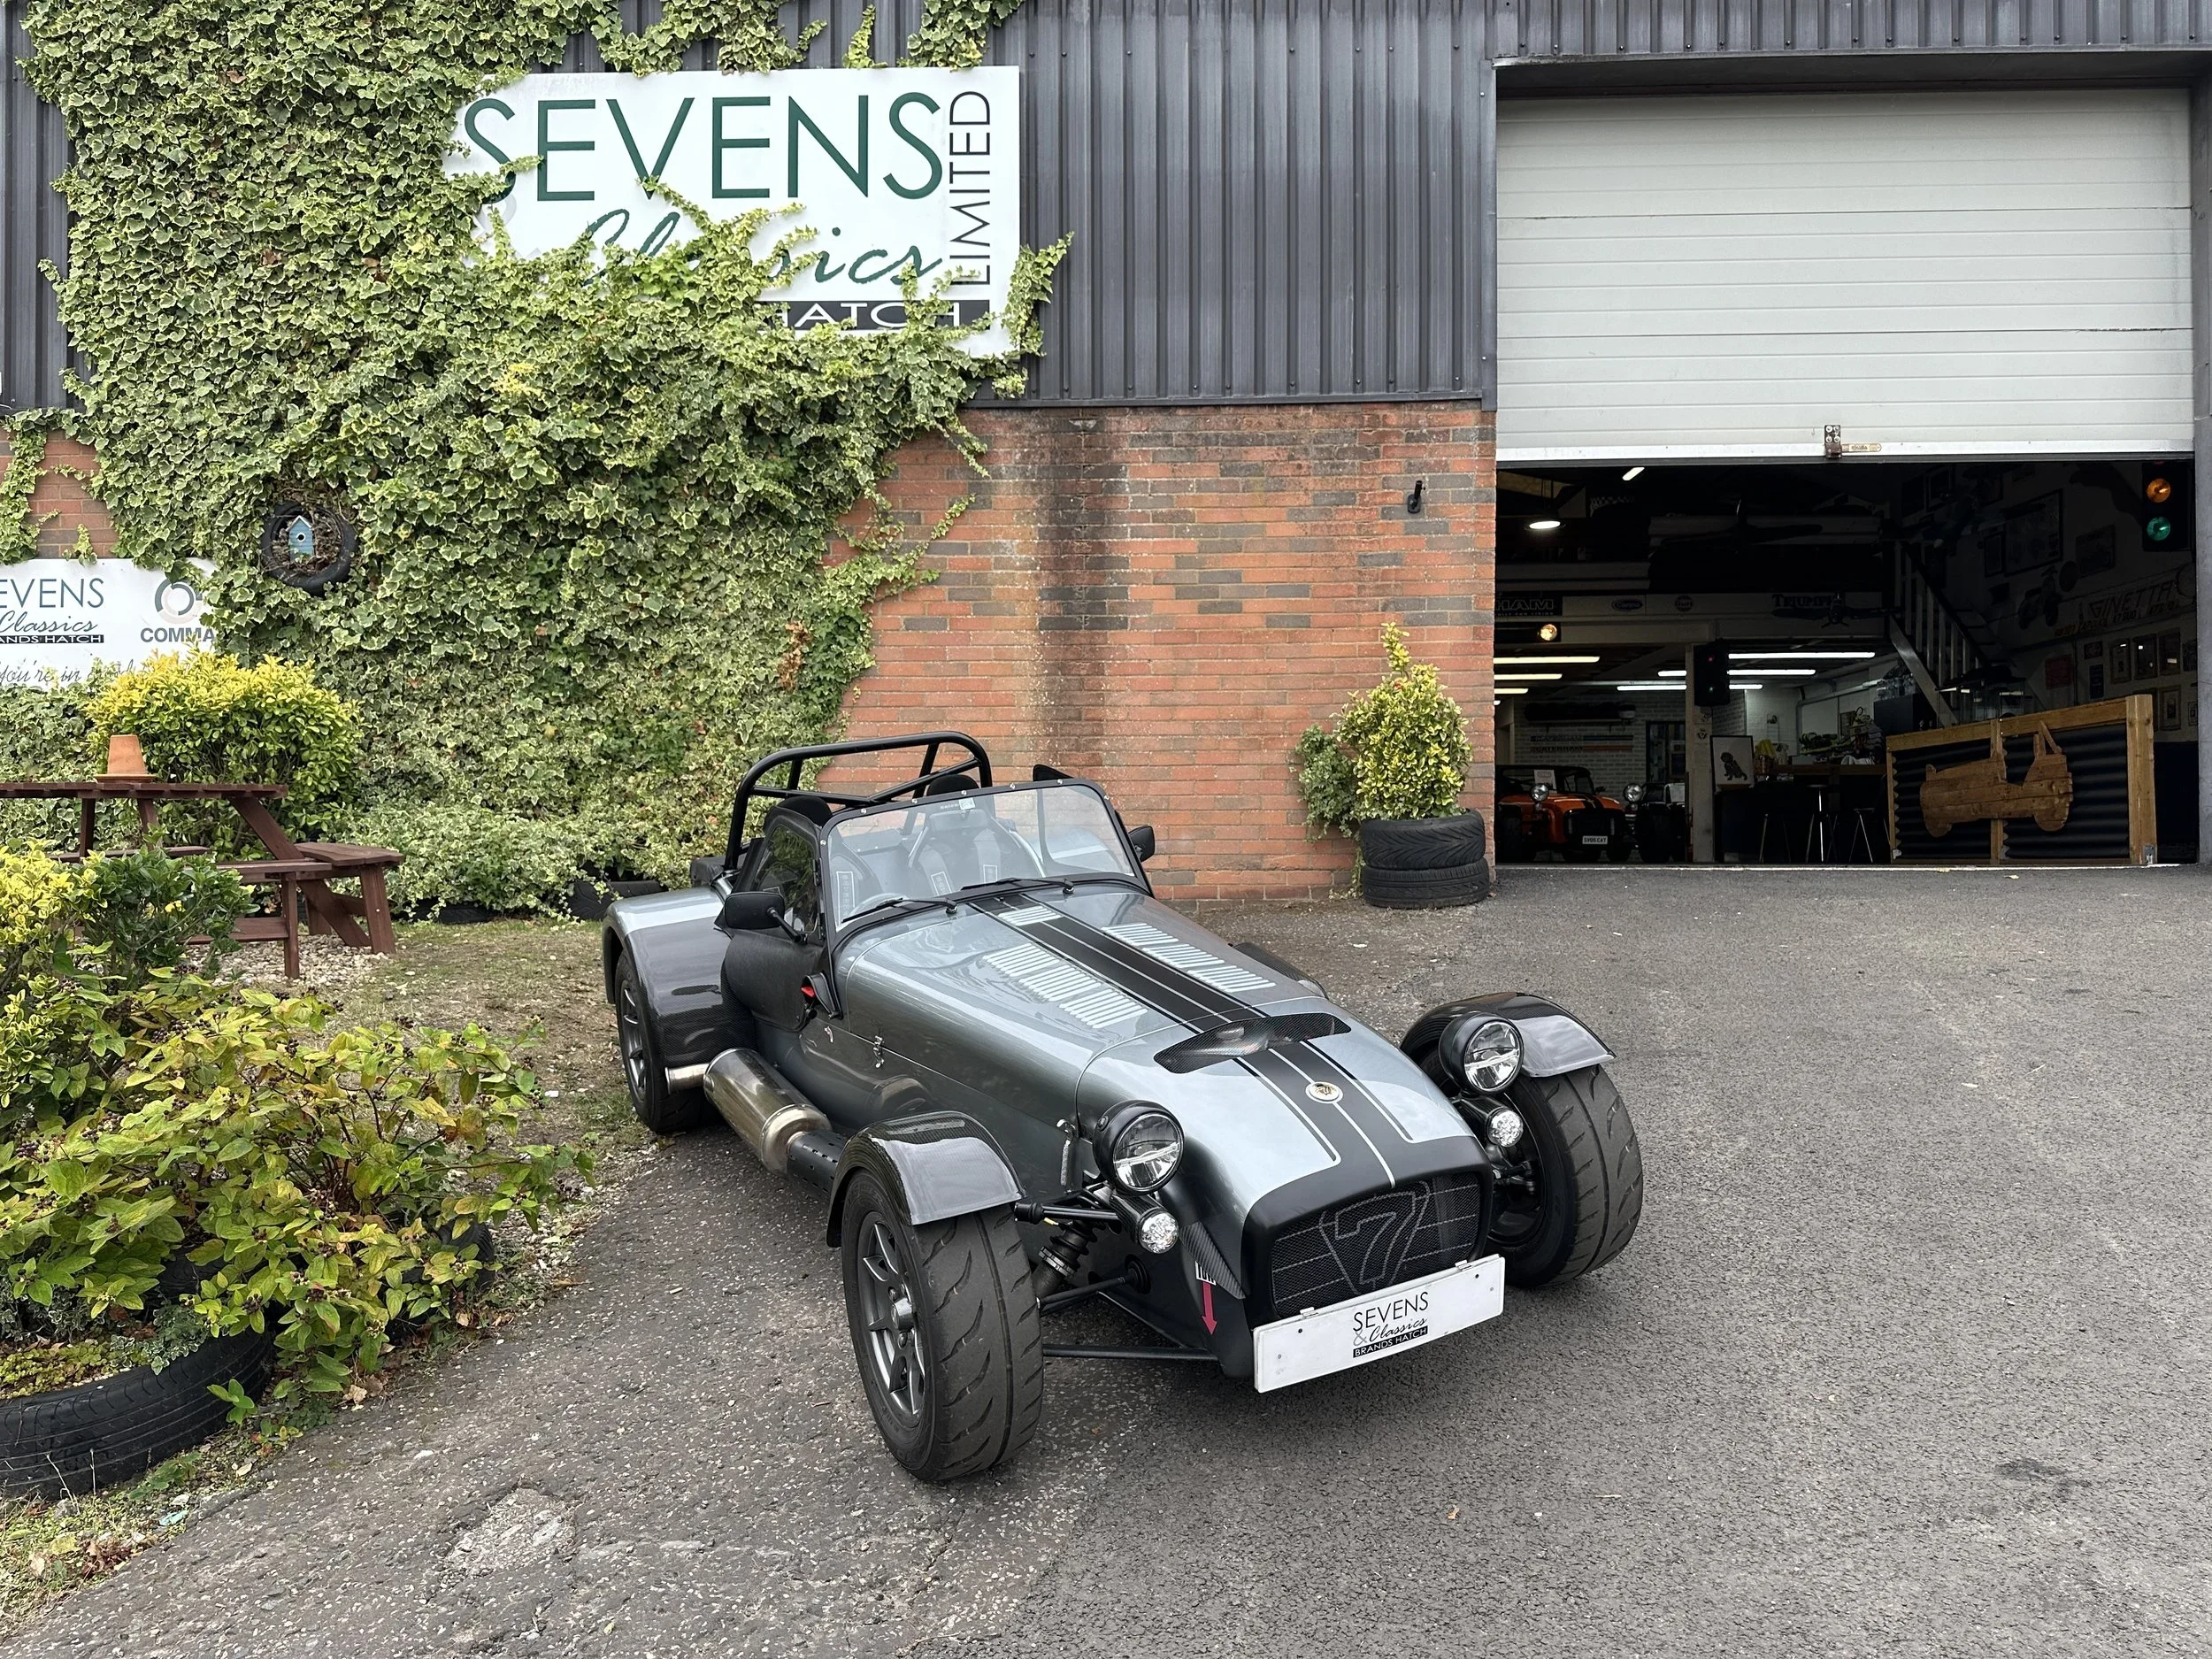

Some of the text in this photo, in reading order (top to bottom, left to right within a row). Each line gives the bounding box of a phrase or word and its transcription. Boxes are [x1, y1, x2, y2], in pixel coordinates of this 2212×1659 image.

[463, 91, 943, 203] SEVENS
[949, 90, 991, 286] LIMITED
[580, 208, 943, 287] Clsics
[0, 610, 99, 634] Classics
[140, 626, 215, 643] COMMA
[60, 665, 82, 682] in
[1353, 1291, 1428, 1332] SEVENS
[1353, 1317, 1428, 1347] & Classics
[1355, 1327, 1427, 1356] BRANDS HATCH
